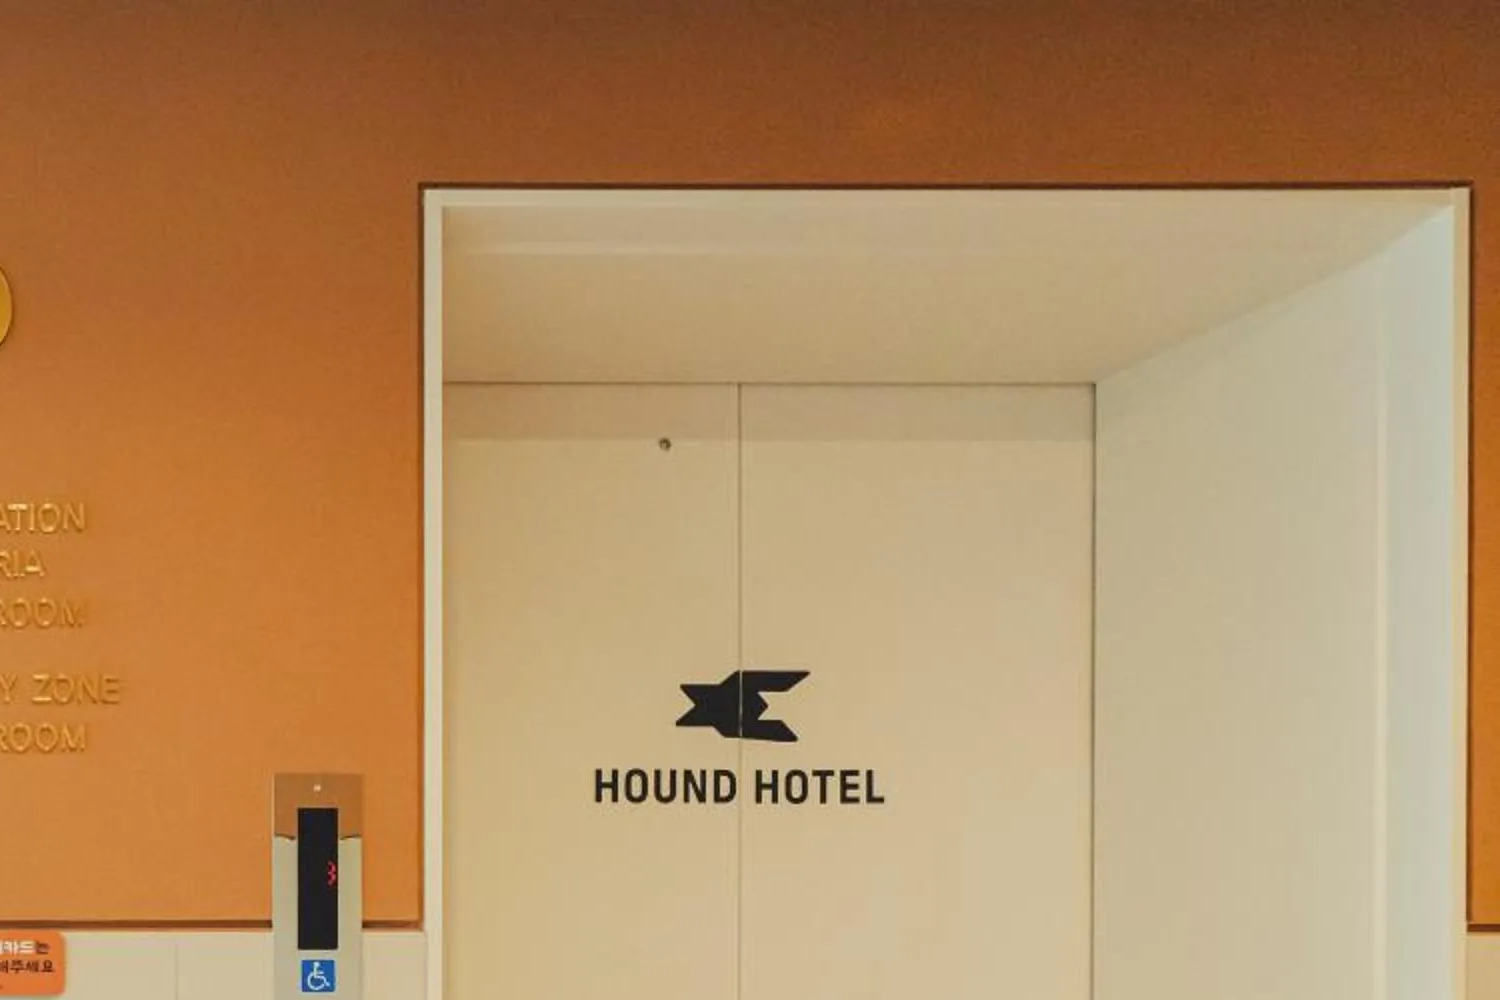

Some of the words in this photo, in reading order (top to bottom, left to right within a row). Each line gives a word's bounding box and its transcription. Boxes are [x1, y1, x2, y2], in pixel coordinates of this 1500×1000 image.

[30, 673, 122, 706] ZONE
[594, 768, 737, 804] HOUND
[755, 769, 885, 804] HOTEL
